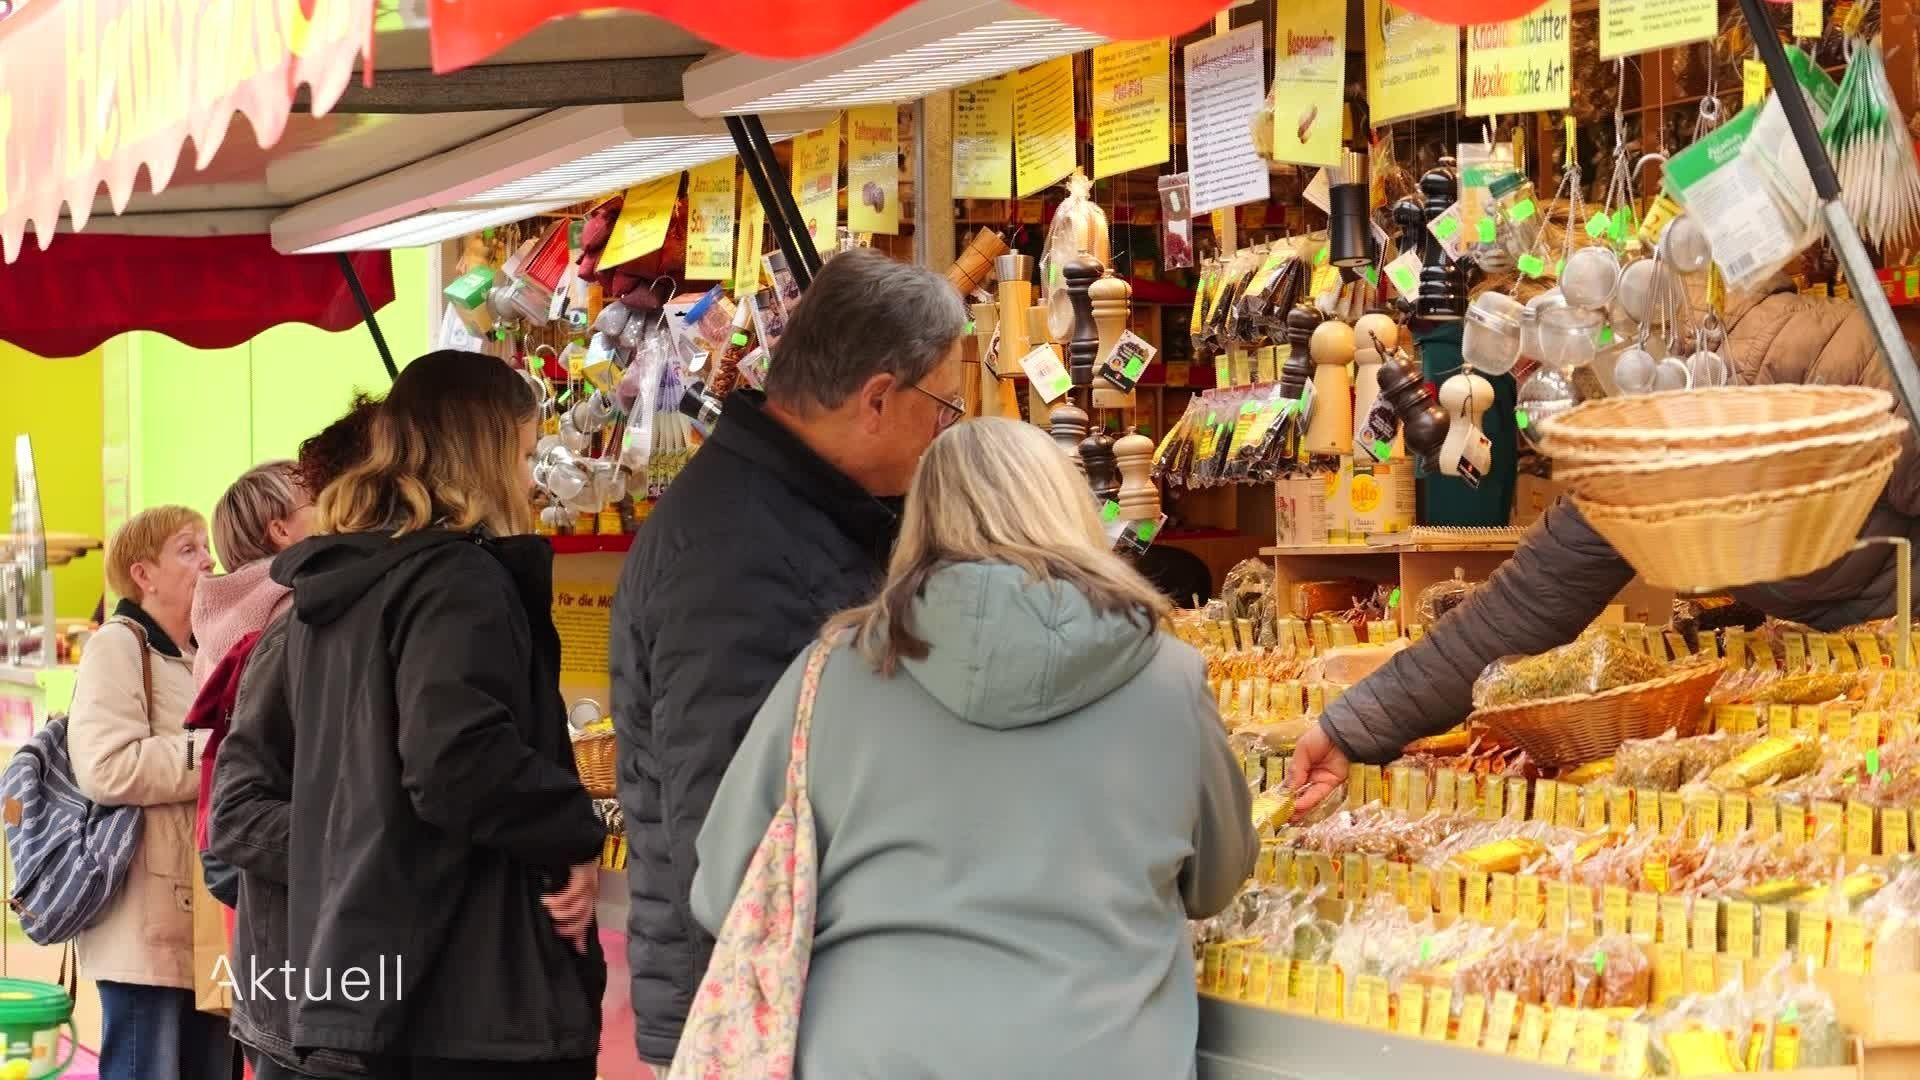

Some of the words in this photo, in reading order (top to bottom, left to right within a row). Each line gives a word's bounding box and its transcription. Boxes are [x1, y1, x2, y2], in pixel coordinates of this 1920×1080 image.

[1545, 59, 1565, 92] Art
[558, 592, 575, 607] für
[578, 593, 593, 607] die
